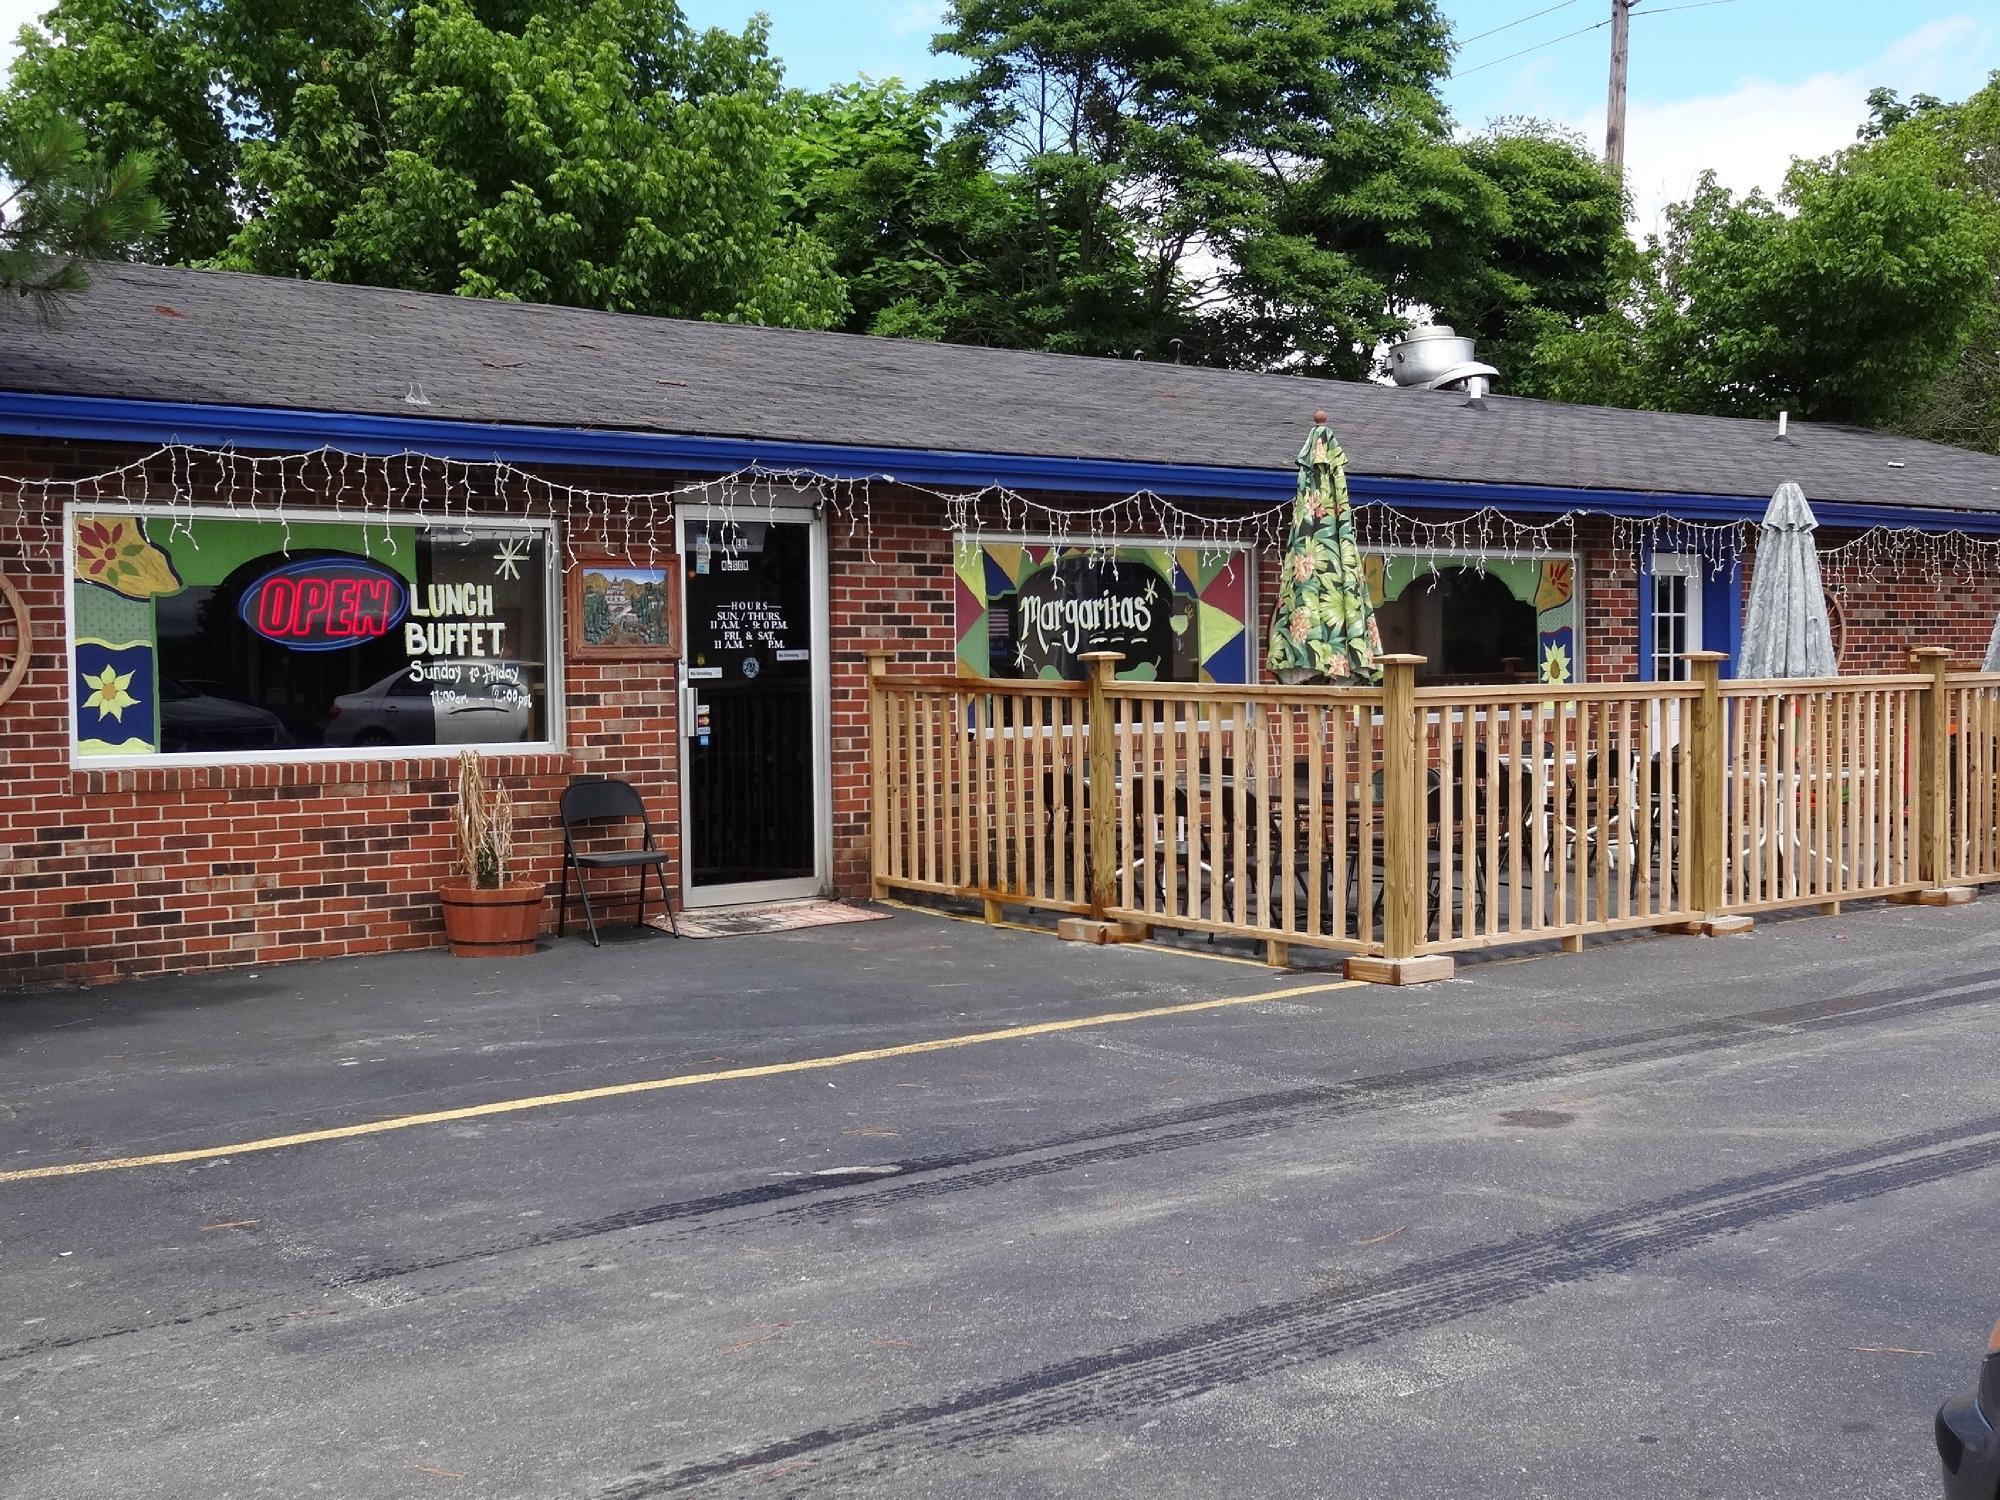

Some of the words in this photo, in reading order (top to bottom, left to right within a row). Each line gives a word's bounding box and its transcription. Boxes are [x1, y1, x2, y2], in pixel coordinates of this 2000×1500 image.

[259, 577, 391, 636] OPEN
[410, 583, 495, 617] LUNCH
[731, 602, 768, 610] HOURS
[745, 631, 753, 640] &
[1019, 590, 1152, 654] Margaritas
[404, 622, 506, 657] BUFFET
[409, 659, 461, 683] Sunday
[468, 667, 480, 683] to
